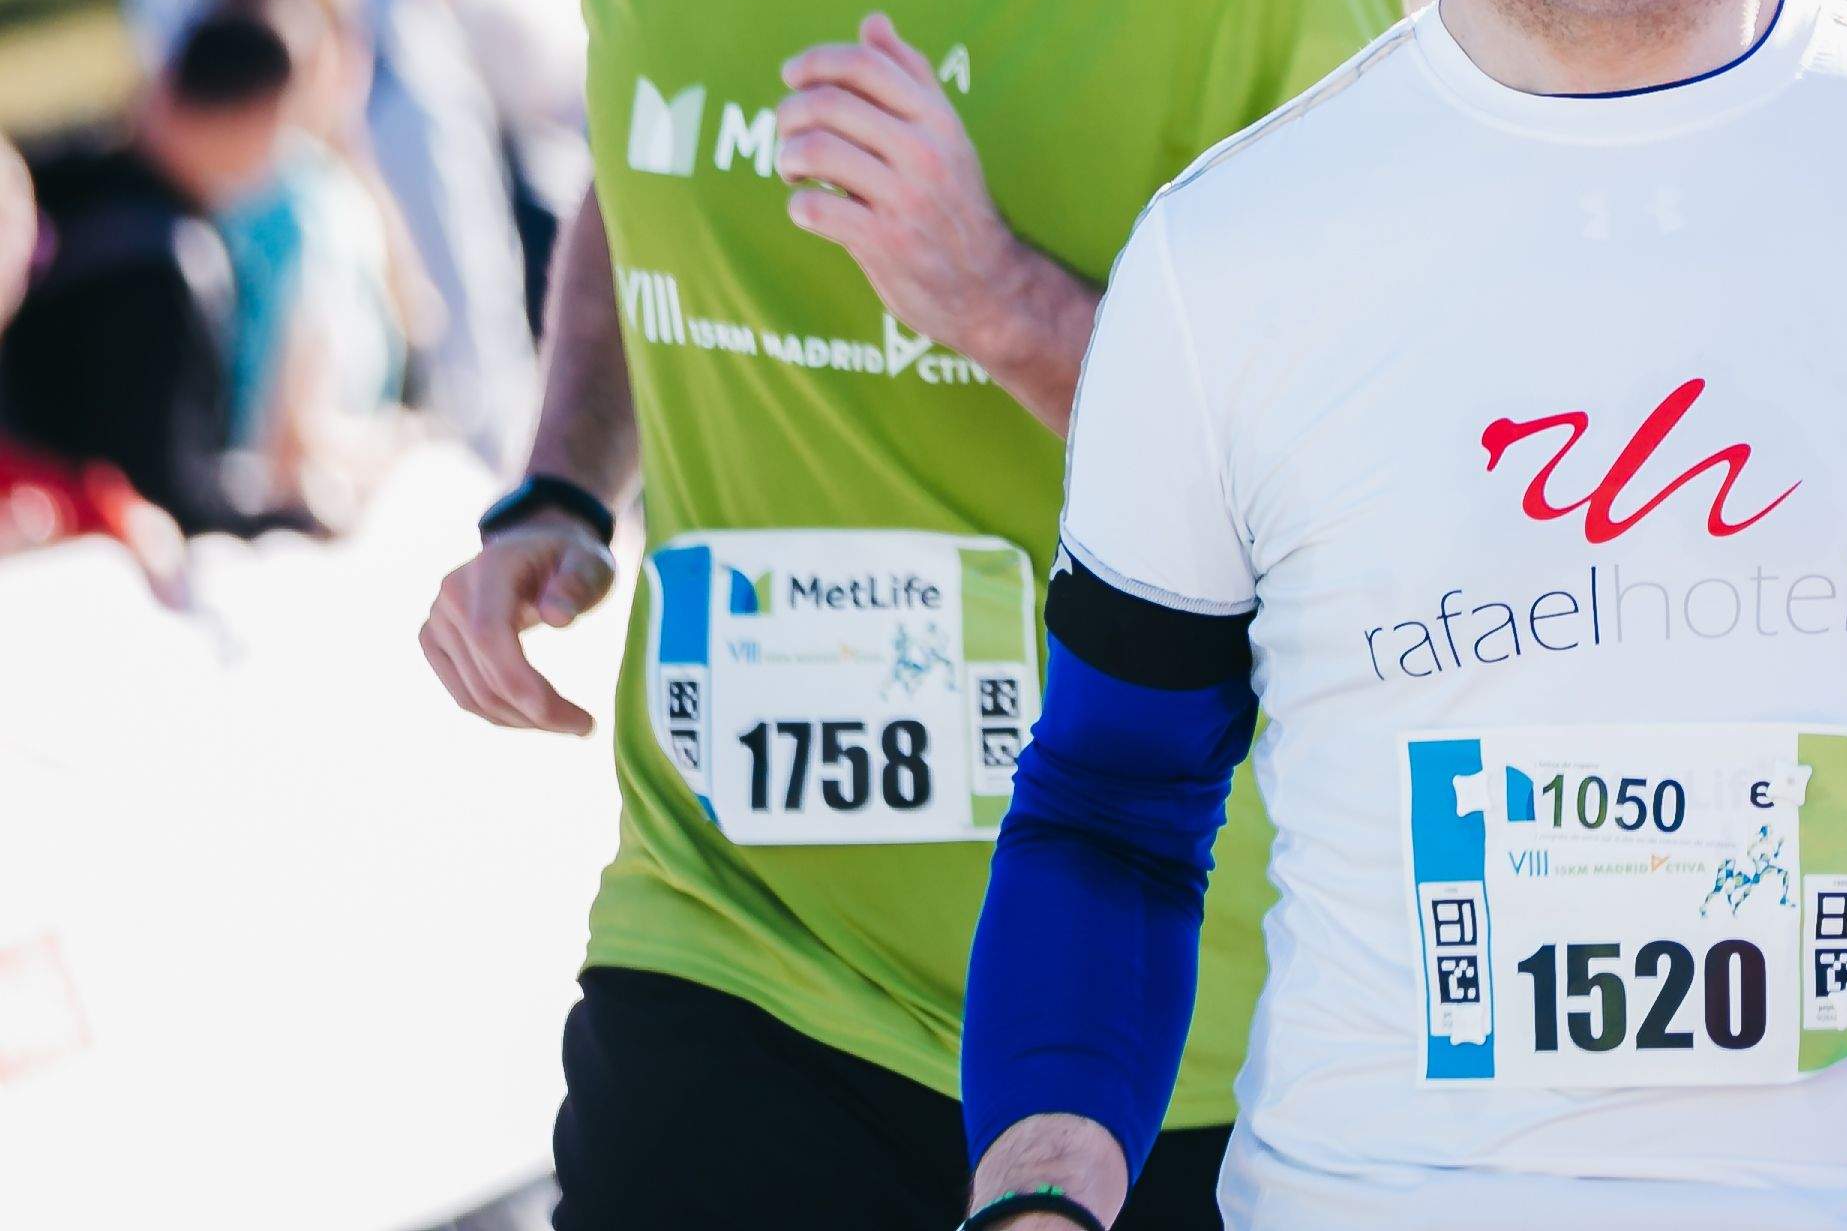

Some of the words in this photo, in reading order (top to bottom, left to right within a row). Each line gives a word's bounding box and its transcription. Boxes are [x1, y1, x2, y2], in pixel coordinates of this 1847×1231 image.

[789, 574, 941, 610] MetLife
[738, 720, 932, 812] 1758
[1542, 774, 1686, 833] 1050
[1508, 850, 1549, 878] VIII
[1517, 939, 1767, 1052] 1520
